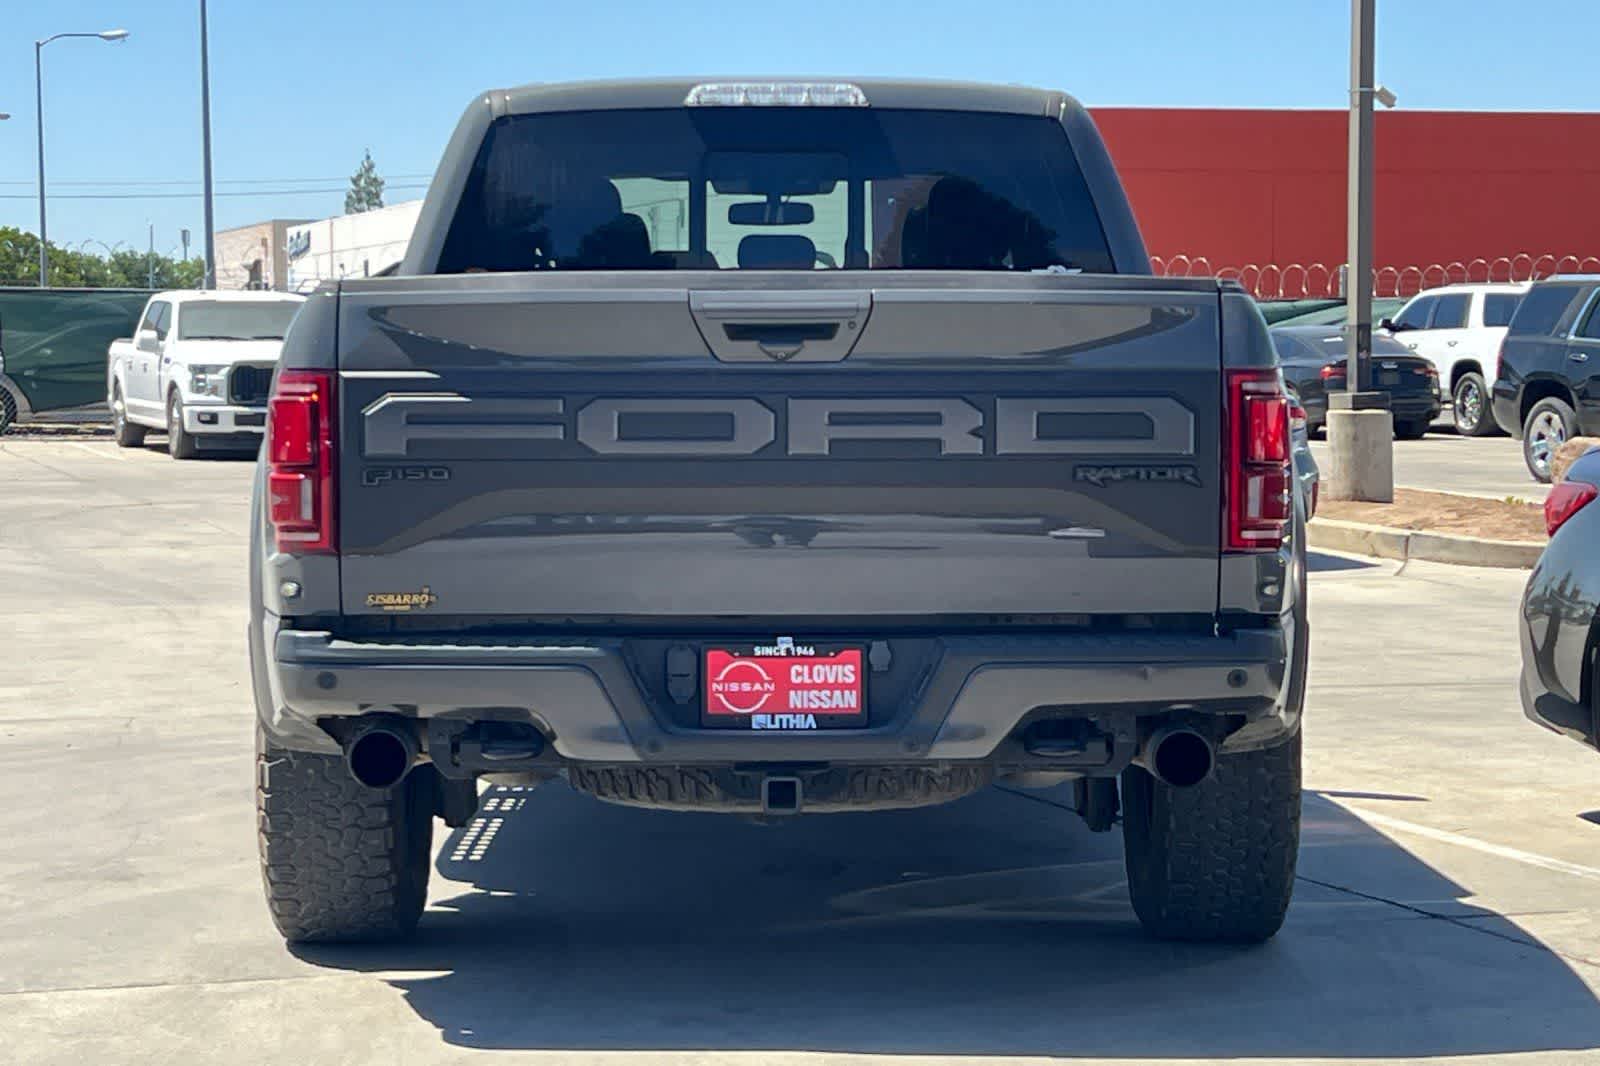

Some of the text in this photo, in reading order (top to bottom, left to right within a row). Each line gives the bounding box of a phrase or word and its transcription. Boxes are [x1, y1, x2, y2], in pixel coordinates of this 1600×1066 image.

[363, 395, 1195, 457] FORD
[1074, 466, 1200, 487] RAPTOR
[754, 646, 815, 656] SINCE 1946
[790, 664, 856, 684] CLOVIS
[711, 682, 776, 692] NISSAN
[789, 690, 857, 709] NISSAN
[767, 714, 817, 729] LITHIA
